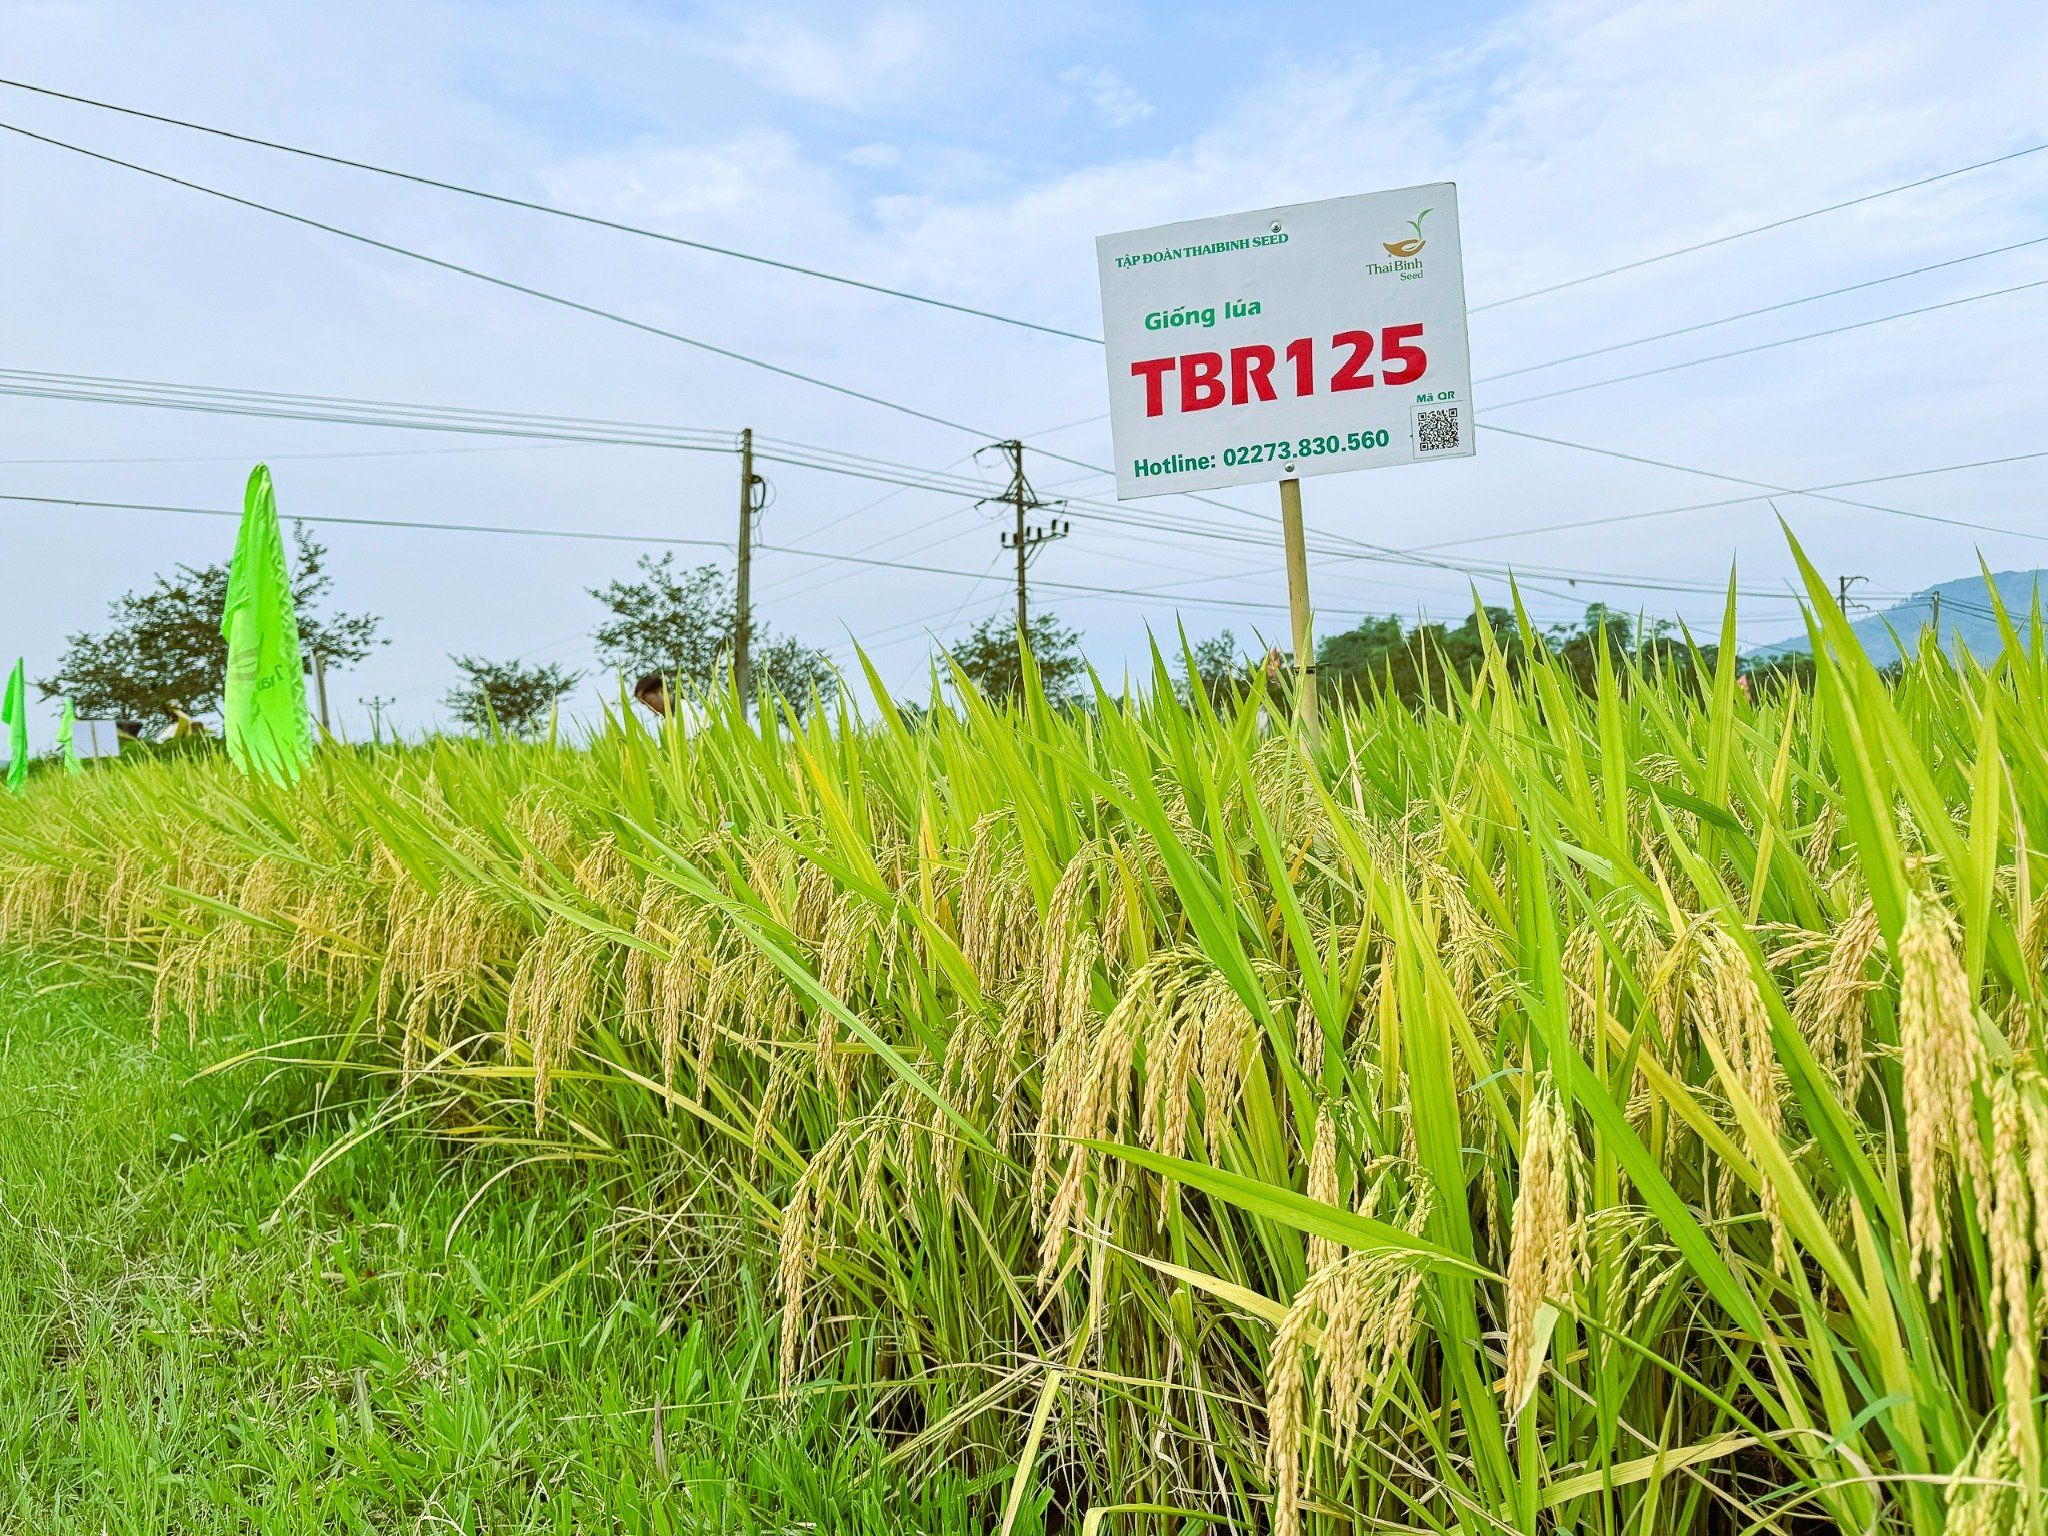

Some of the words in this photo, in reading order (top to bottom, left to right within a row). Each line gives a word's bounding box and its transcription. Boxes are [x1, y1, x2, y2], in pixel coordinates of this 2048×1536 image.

[1115, 253, 1141, 270] TẬP
[1142, 247, 1182, 264] ĐOÀN
[1183, 239, 1250, 258] THAIBINH
[1252, 233, 1289, 248] SEED
[1400, 269, 1424, 281] Seed
[1145, 306, 1215, 331] Giống
[1225, 299, 1261, 319] lúa
[1131, 323, 1428, 418] TBR125
[1437, 390, 1455, 401] QR
[1134, 454, 1216, 478] Hotline:
[1223, 429, 1389, 467] 02273.830.560
